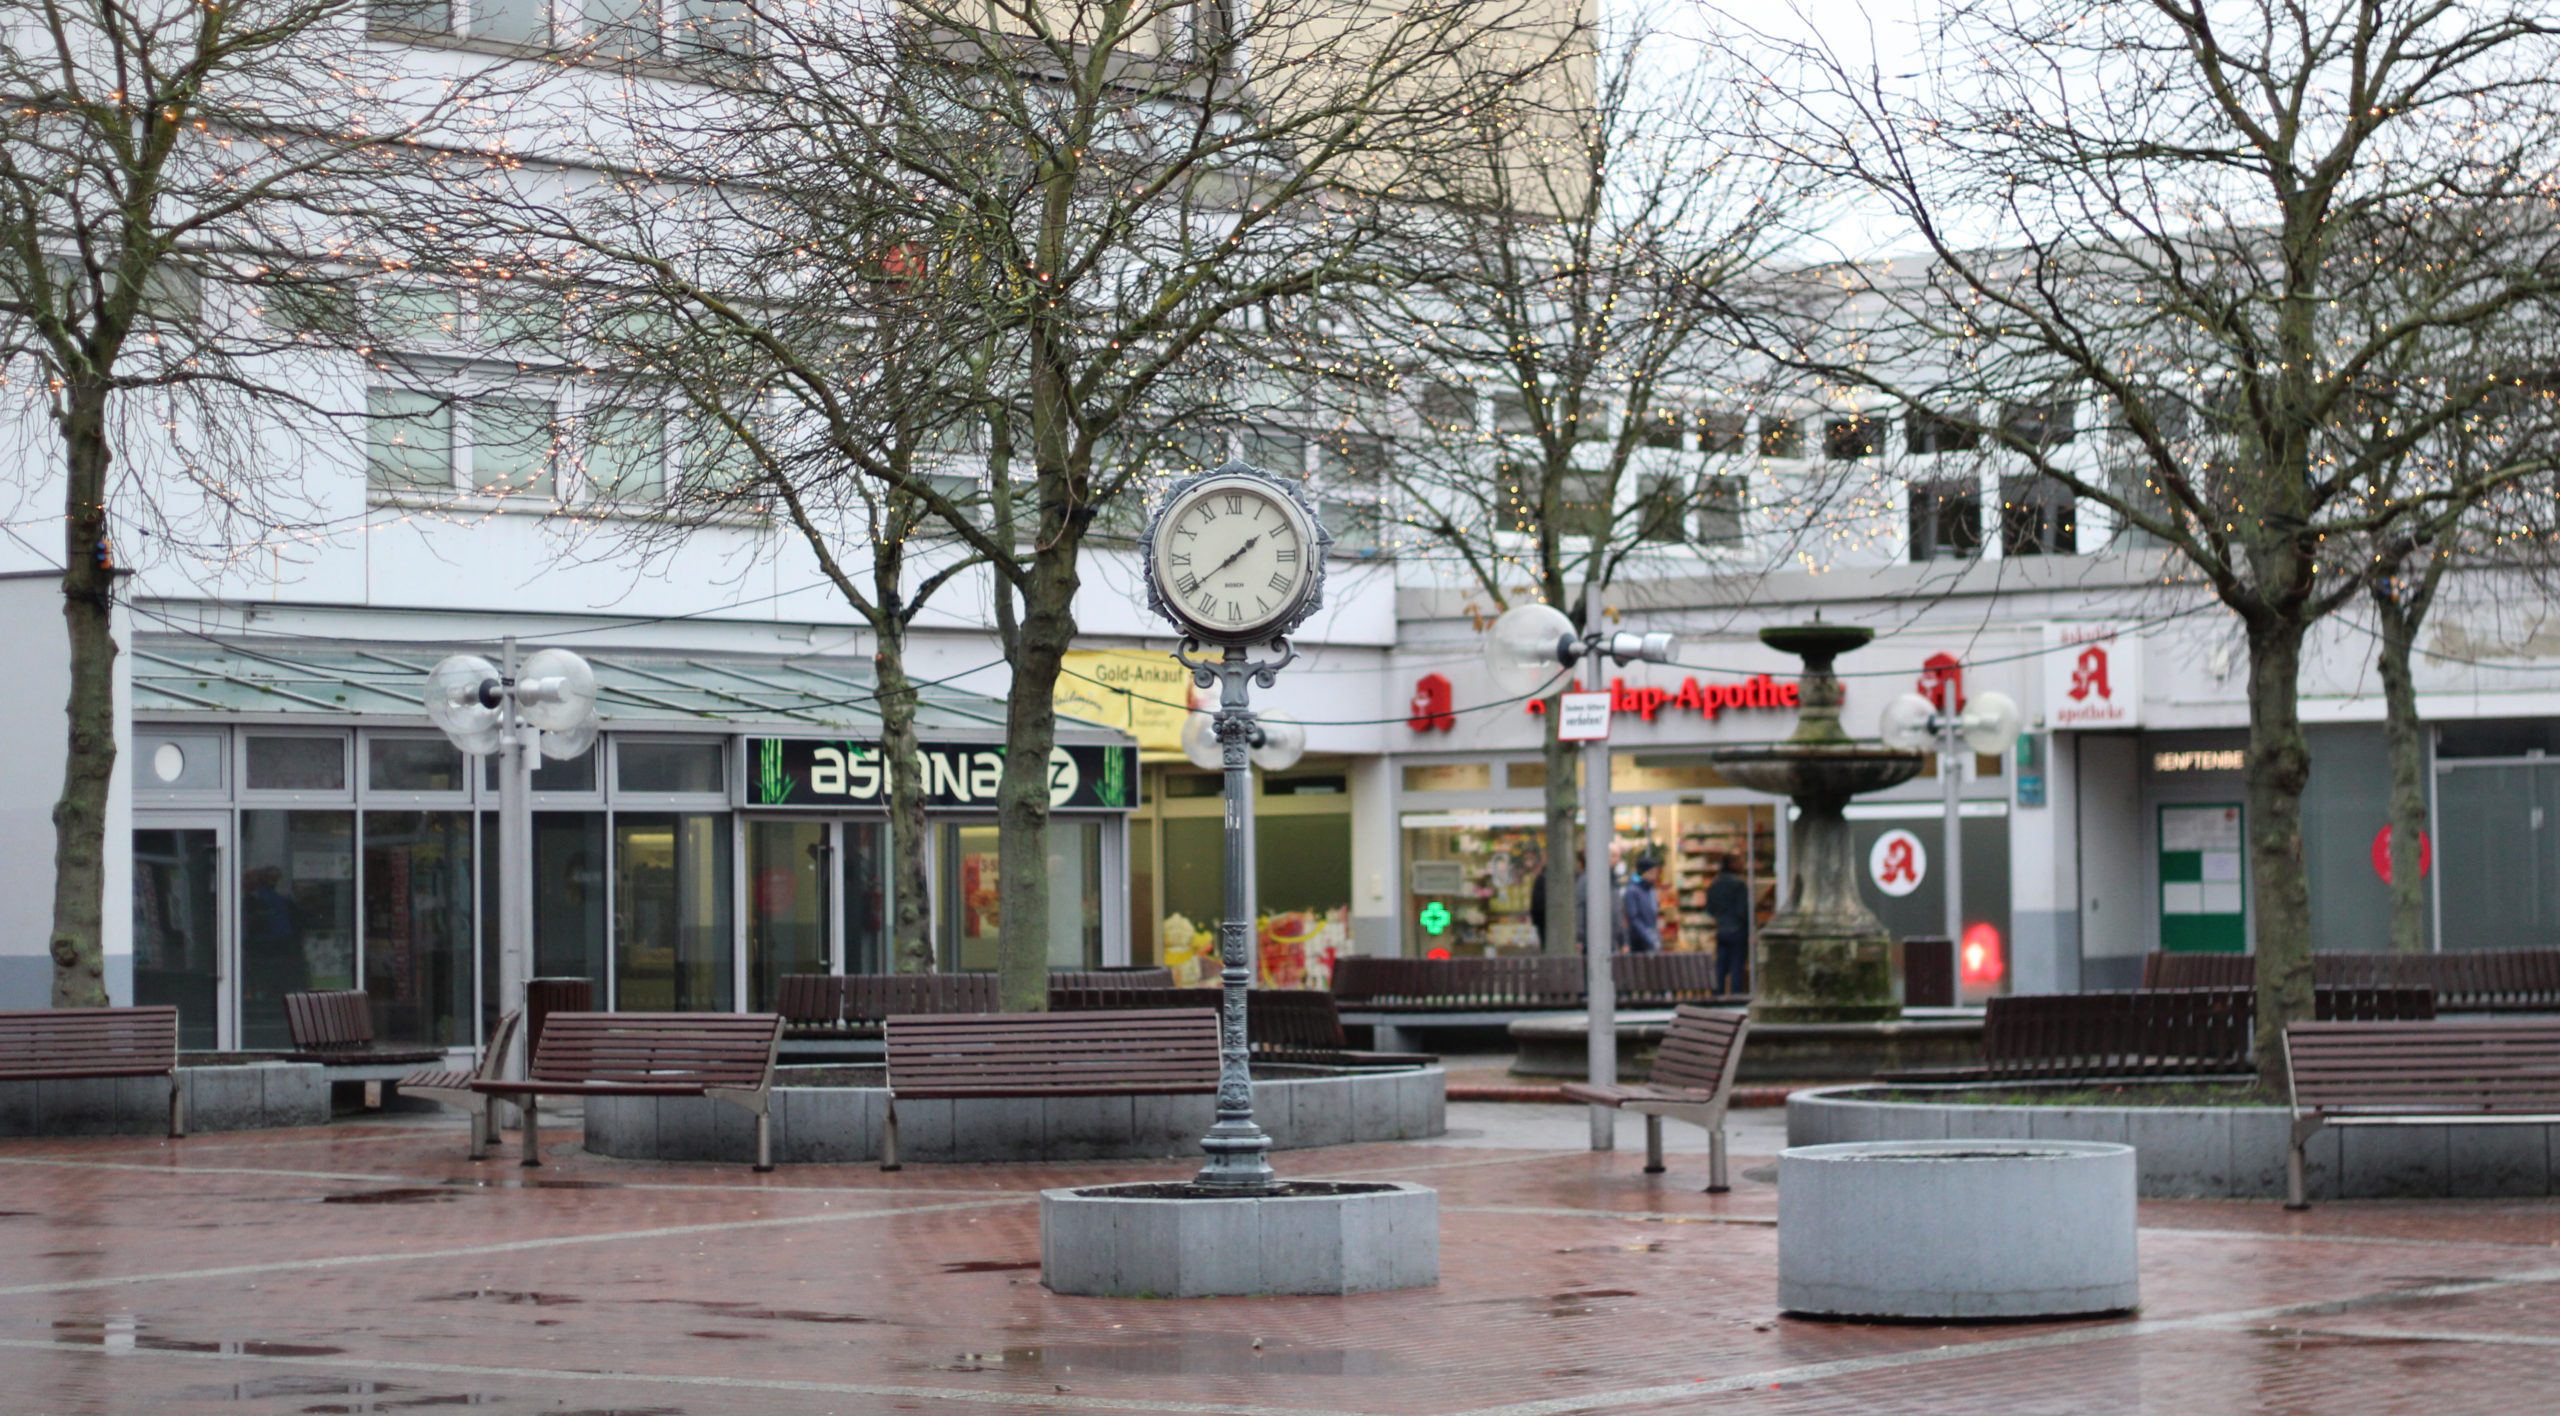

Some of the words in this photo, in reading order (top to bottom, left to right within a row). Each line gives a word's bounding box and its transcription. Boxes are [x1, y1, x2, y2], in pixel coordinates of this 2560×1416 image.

[1197, 503, 1216, 524] XI
[1225, 495, 1242, 515] XII
[1177, 525, 1197, 541] X
[1269, 523, 1289, 539] II
[1172, 552, 1191, 566] IX
[1276, 550, 1296, 562] III
[1198, 592, 1217, 617] VII
[1228, 601, 1243, 621] VI
[1096, 664, 1183, 684] Gold-Ankauf
[2153, 750, 2245, 772] SENFTENBE
